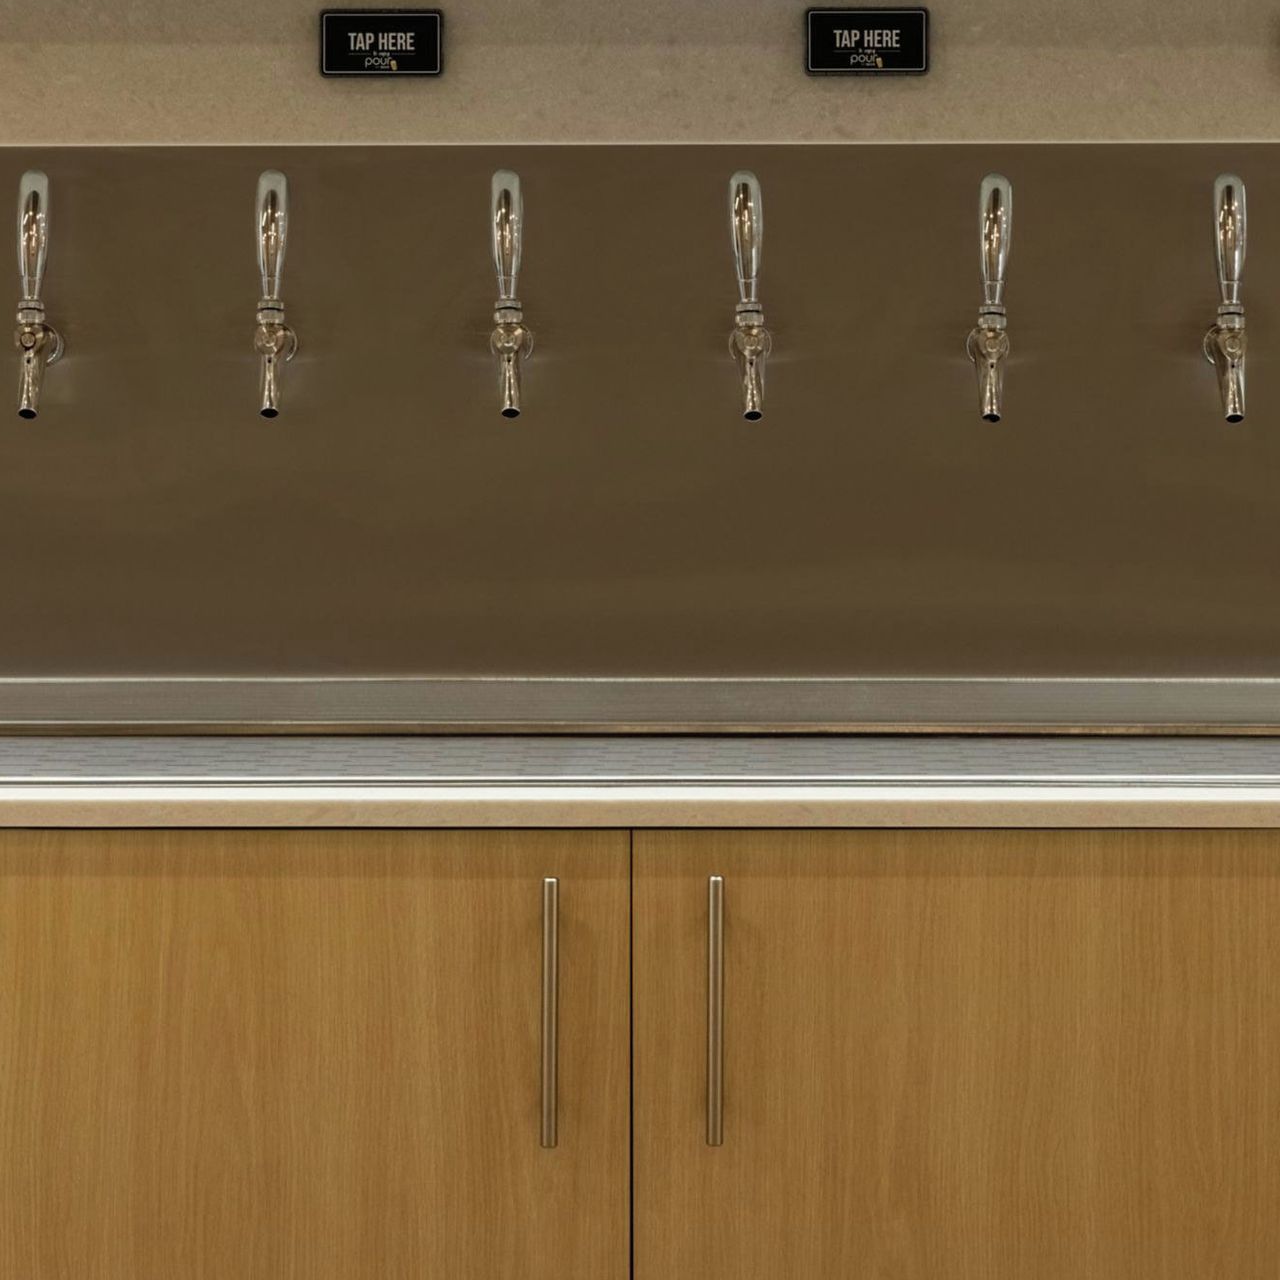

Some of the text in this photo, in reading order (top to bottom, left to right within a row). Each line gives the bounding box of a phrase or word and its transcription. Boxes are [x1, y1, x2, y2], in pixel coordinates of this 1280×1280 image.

[348, 32, 415, 50] TAP HERE
[833, 30, 900, 47] TAP HERE
